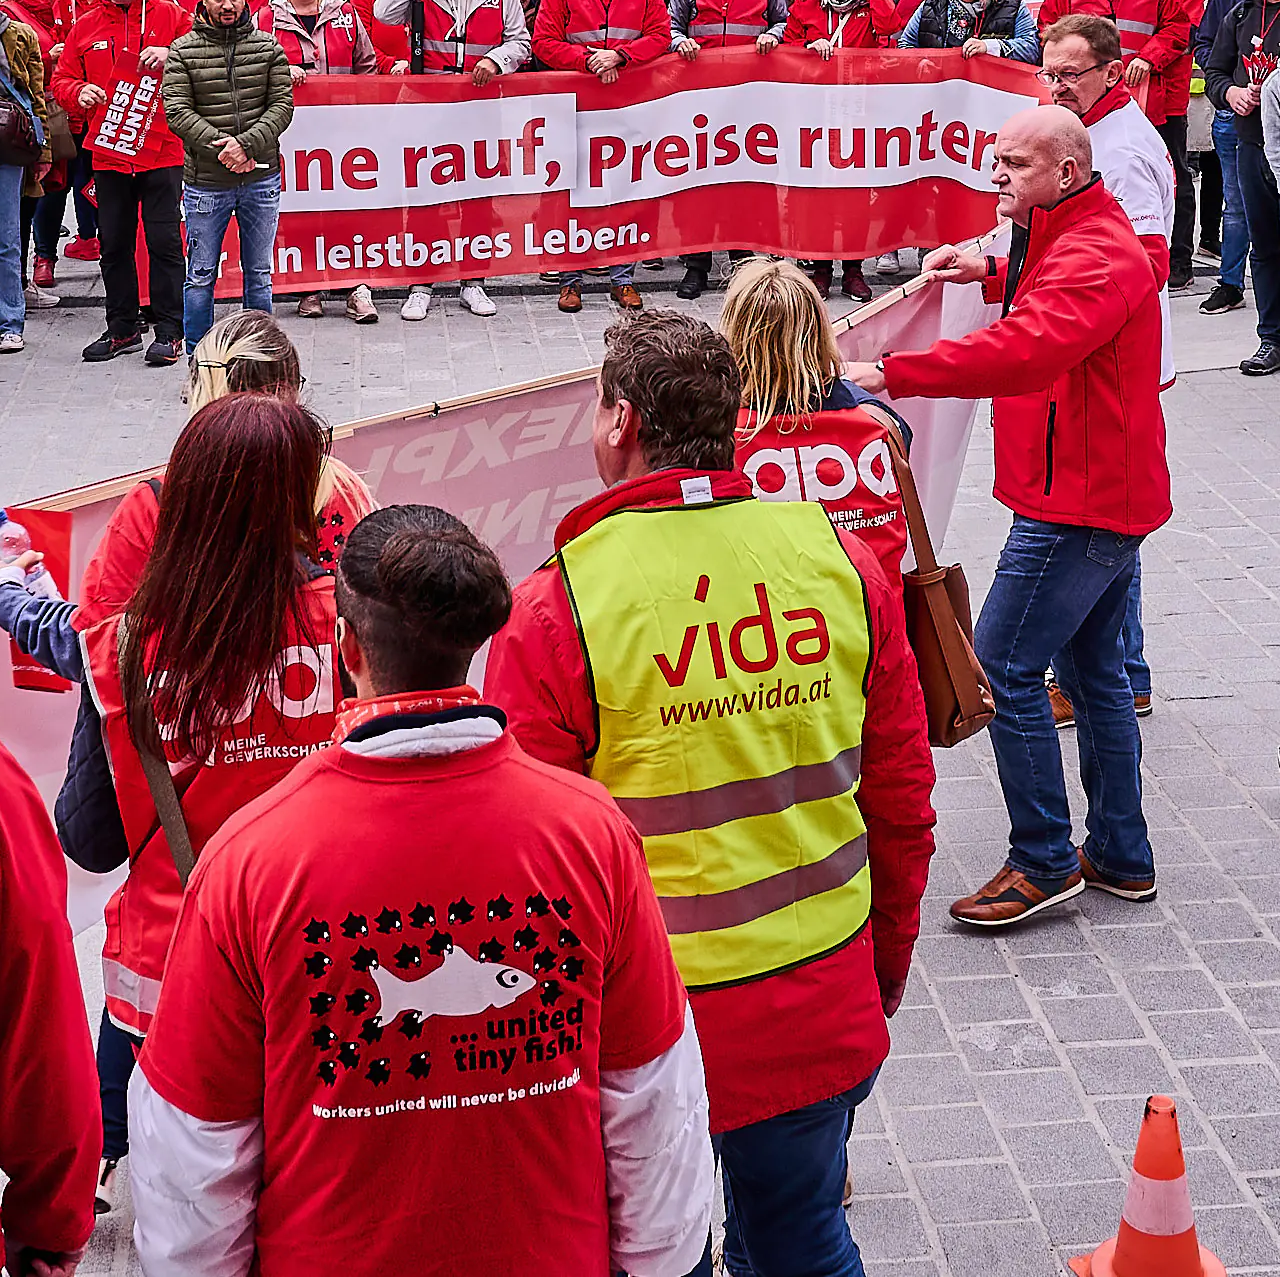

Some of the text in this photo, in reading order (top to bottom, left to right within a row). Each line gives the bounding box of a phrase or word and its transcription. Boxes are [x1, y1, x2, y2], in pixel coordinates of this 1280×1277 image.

[93, 79, 136, 150] PREISE
[113, 75, 158, 156] RUNTER
[403, 113, 779, 189] rauf, Preise
[315, 219, 651, 271] leistbares Leben.
[653, 574, 831, 688] vida
[659, 672, 832, 727] www.vida.at
[223, 733, 266, 752] MEINE
[486, 998, 584, 1041] united
[453, 1026, 584, 1075] tiny fish!
[375, 1096, 426, 1116] united
[429, 1095, 457, 1109] will
[461, 1092, 504, 1107] never
[508, 1087, 525, 1102] be
